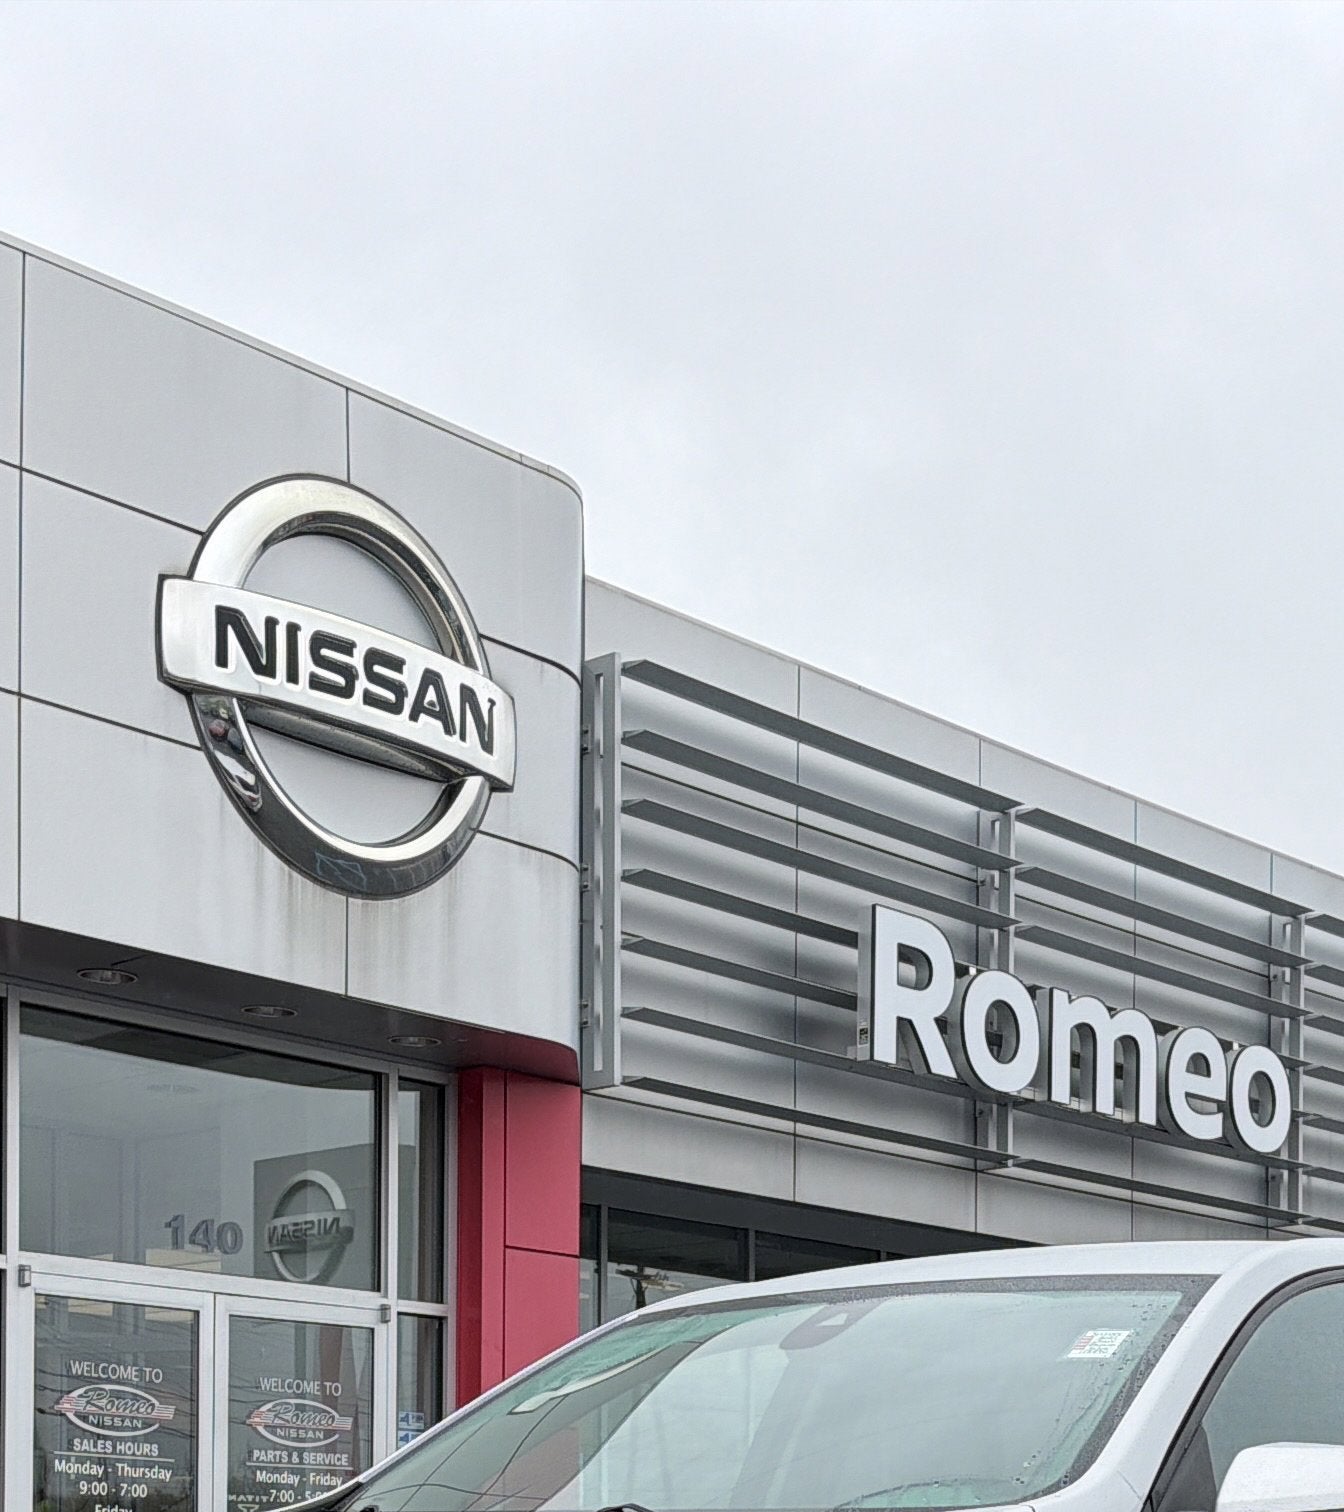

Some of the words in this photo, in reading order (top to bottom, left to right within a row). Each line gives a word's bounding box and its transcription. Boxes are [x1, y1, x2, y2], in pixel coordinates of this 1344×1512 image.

[214, 604, 497, 757] NISSAN
[868, 903, 1293, 1154] Romeo
[164, 1214, 244, 1255] 140
[69, 1360, 140, 1382] WELCOME
[144, 1367, 163, 1384] TO
[258, 1376, 321, 1394] WELCOME
[324, 1382, 342, 1397] TO
[78, 1386, 156, 1416] Romeo
[88, 1414, 142, 1428] NISSAN
[270, 1401, 336, 1427] Romeo
[276, 1427, 324, 1440] NISSAN
[73, 1437, 113, 1454] SALES
[116, 1440, 159, 1456] HOURS
[253, 1449, 288, 1463] PARTS
[292, 1451, 299, 1463] &
[303, 1452, 349, 1466] SERVICE
[54, 1459, 104, 1478] Monday
[115, 1463, 172, 1482] Thursday
[256, 1470, 300, 1487] Monday
[309, 1472, 343, 1488] Friday
[79, 1481, 108, 1496] 9:00
[120, 1483, 148, 1498] 7:00
[269, 1489, 294, 1503] 7:00
